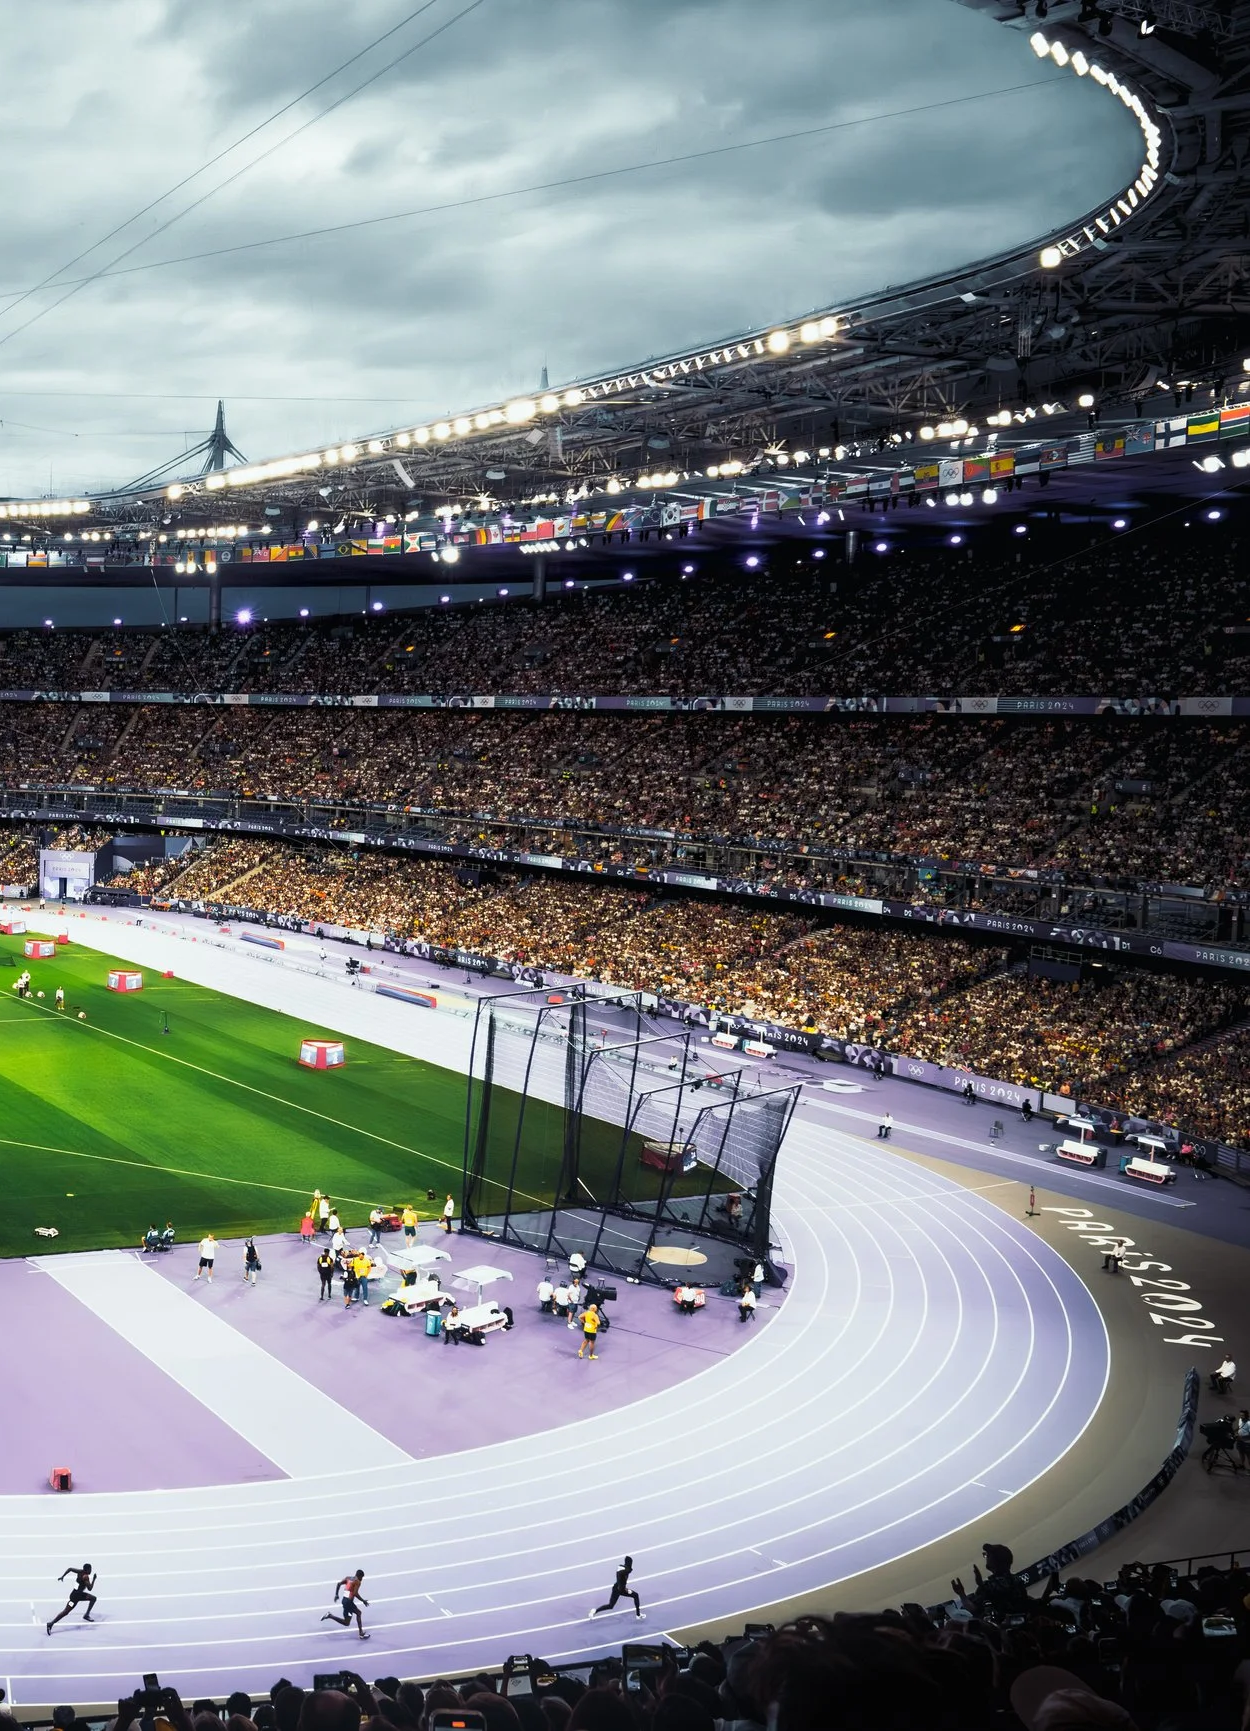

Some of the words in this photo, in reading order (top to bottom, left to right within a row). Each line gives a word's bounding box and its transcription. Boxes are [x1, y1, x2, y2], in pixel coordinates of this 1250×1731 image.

[1017, 701, 1044, 710] PARIS
[1048, 701, 1074, 710] 2024
[833, 898, 852, 907] PARIS
[987, 920, 1010, 930] PARIS
[1012, 923, 1034, 934] 2024
[1122, 941, 1130, 950] D1
[1150, 945, 1162, 955] C6
[1196, 951, 1225, 963] PARIS
[1229, 956, 1250, 967] 202
[784, 1031, 808, 1046] 2024
[990, 1085, 1020, 1101] 2024
